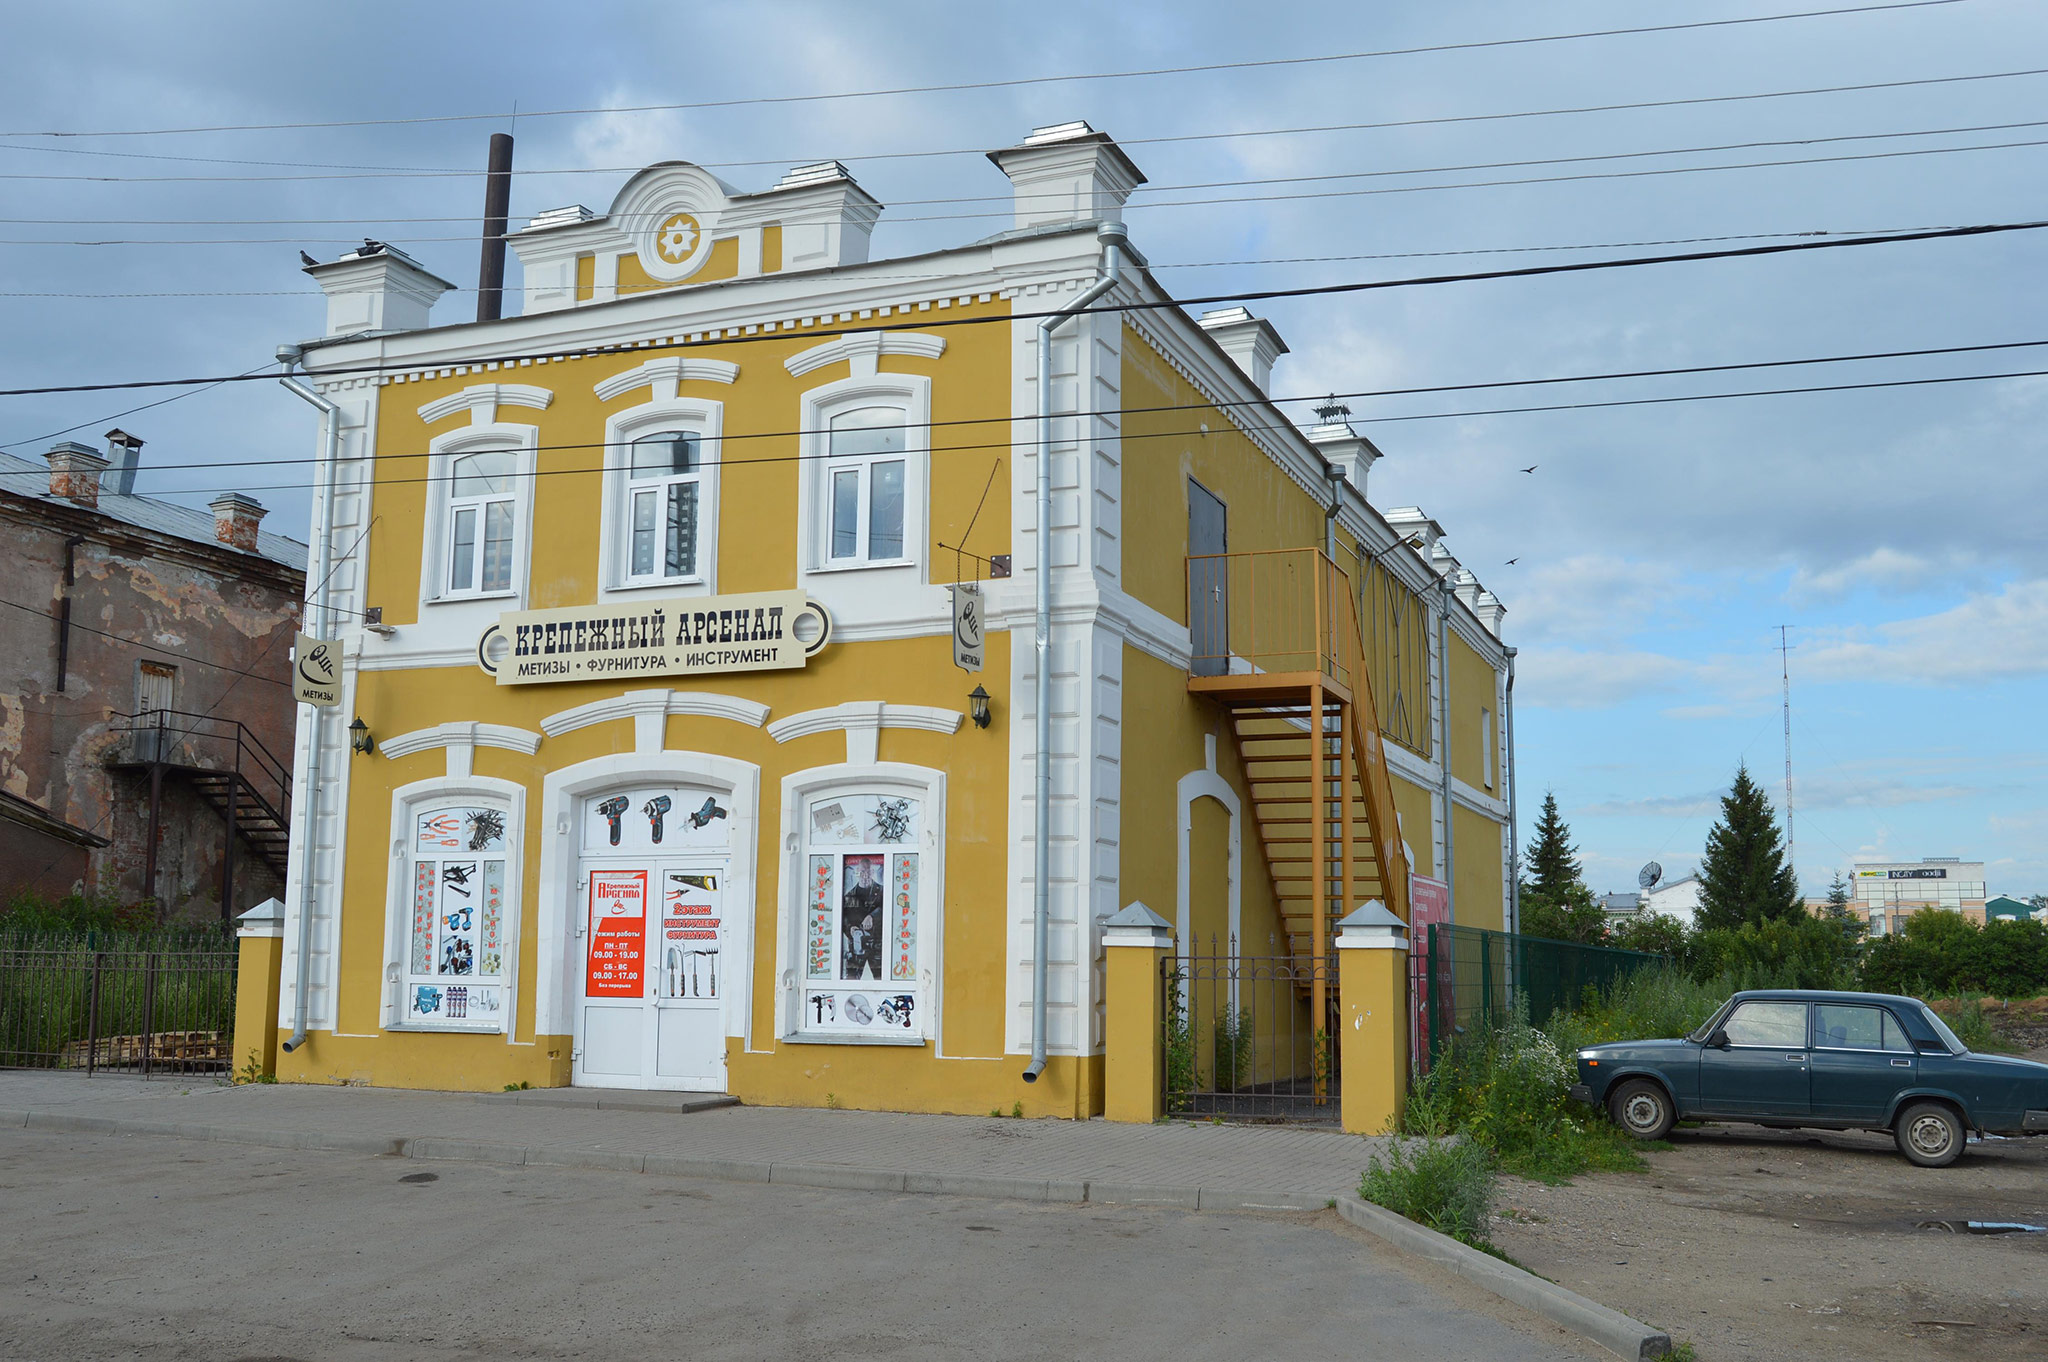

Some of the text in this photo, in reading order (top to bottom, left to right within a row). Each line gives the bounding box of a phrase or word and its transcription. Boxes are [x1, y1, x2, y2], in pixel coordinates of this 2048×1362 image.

[515, 606, 783, 656] КРЕПЕЖНЫЙ АРСЕНАЛ
[518, 648, 778, 677] МЕТИЗЫ ФУРНИТУРА ИНСТРУМЕНТ
[960, 653, 980, 666] МЕТИЗЫ
[302, 689, 334, 701] МЕТИЗЫ
[664, 918, 721, 928] ИНСТРУМЕНТ
[616, 930, 640, 938] работы
[666, 930, 717, 940] ФУРНИТУРА
[593, 971, 612, 979] 09.00
[618, 972, 638, 980] 17.00
